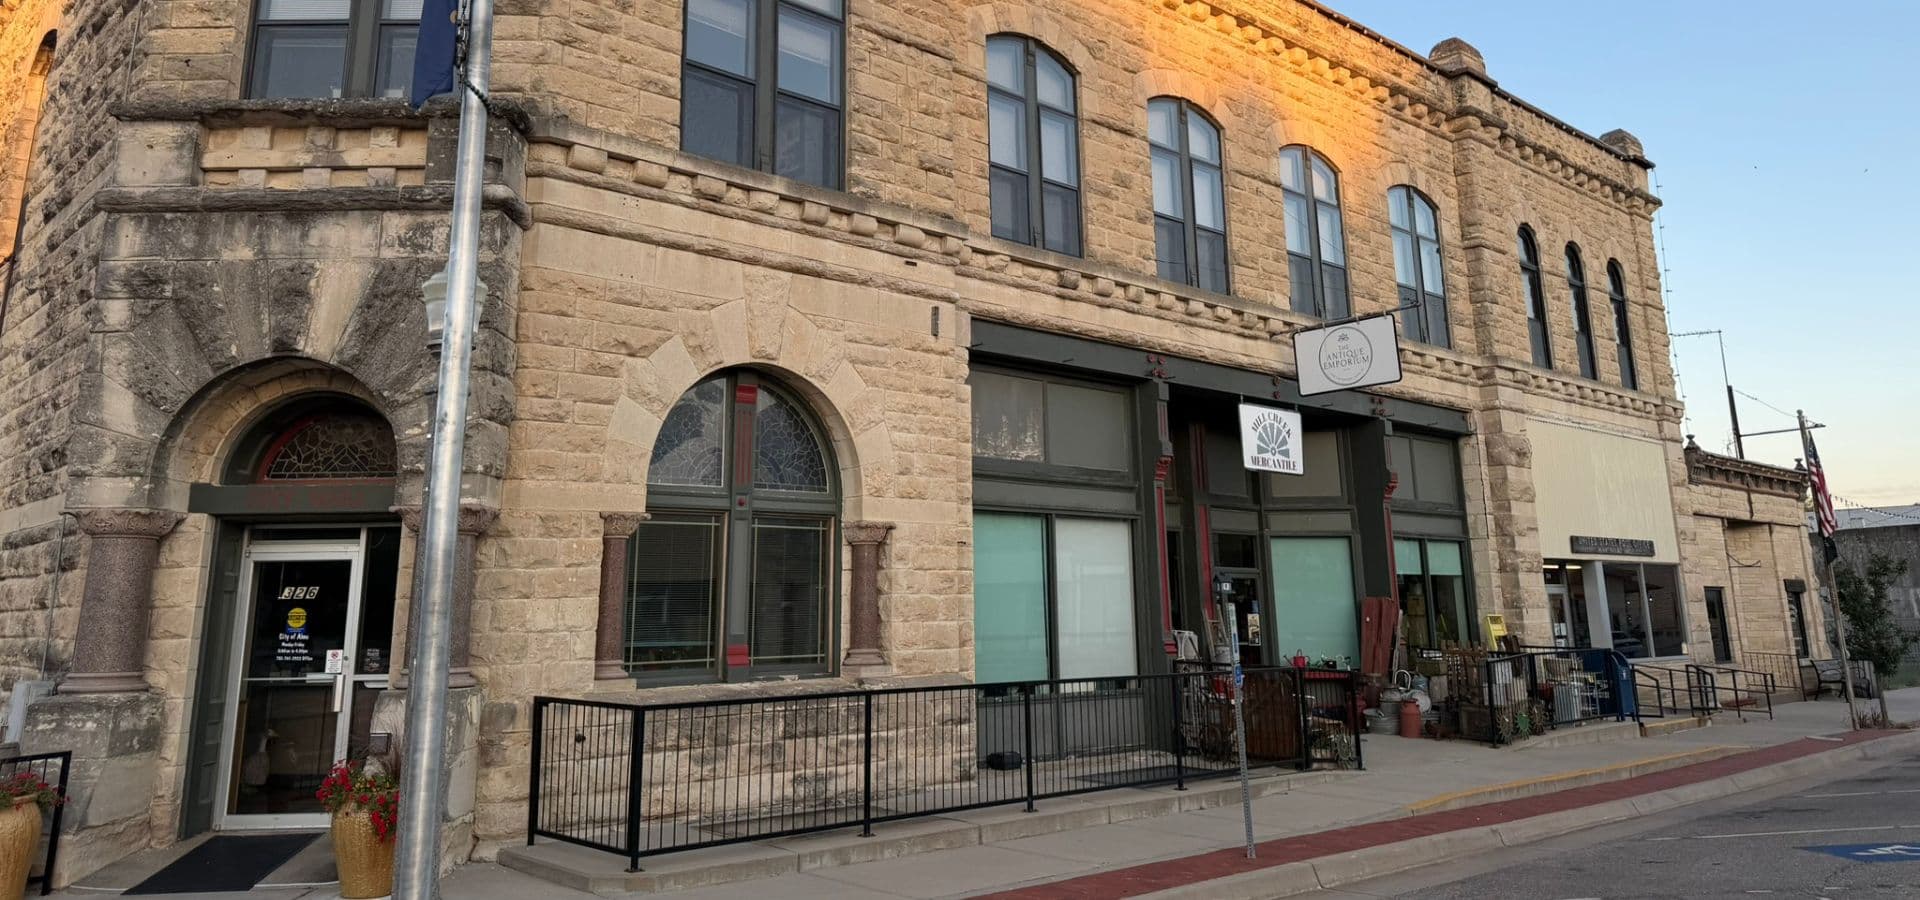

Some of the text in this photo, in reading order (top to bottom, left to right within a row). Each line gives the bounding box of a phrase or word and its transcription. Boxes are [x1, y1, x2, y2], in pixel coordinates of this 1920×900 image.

[1326, 347, 1365, 361] ANTIQUE
[1323, 354, 1370, 370] EMPORIUM
[1268, 411, 1292, 439] CREEK
[1250, 455, 1298, 471] MERCANTILE
[283, 586, 319, 599] 326
[278, 632, 290, 641] City
